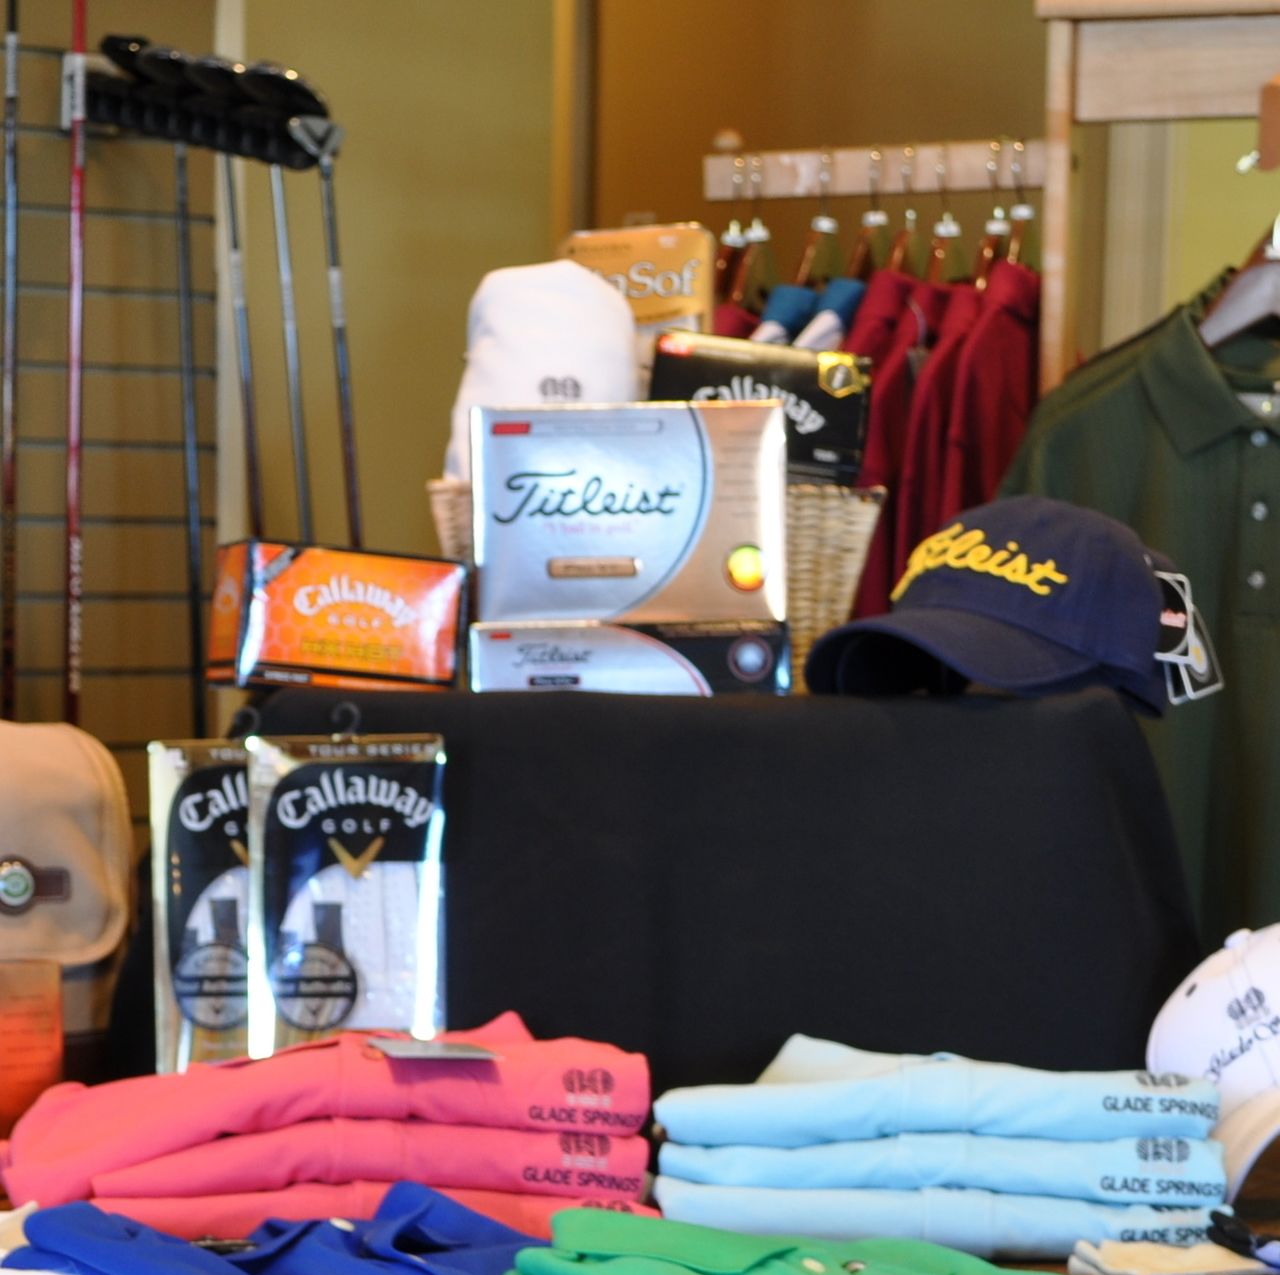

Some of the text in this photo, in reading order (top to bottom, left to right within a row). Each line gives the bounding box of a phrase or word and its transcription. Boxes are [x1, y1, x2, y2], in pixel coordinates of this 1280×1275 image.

[493, 469, 681, 524] Titleist
[293, 574, 418, 629] Callaway
[514, 643, 593, 669] Titleist
[178, 770, 250, 832] Call
[276, 768, 433, 830] Callaway
[321, 818, 393, 836] GOLF
[528, 1104, 645, 1127] GLADE SPRINGS
[1102, 1095, 1220, 1121] GLADE SPRINGS
[522, 1164, 642, 1193] GLADE SPRINGS
[1099, 1174, 1225, 1198] GLADE SPRINGS
